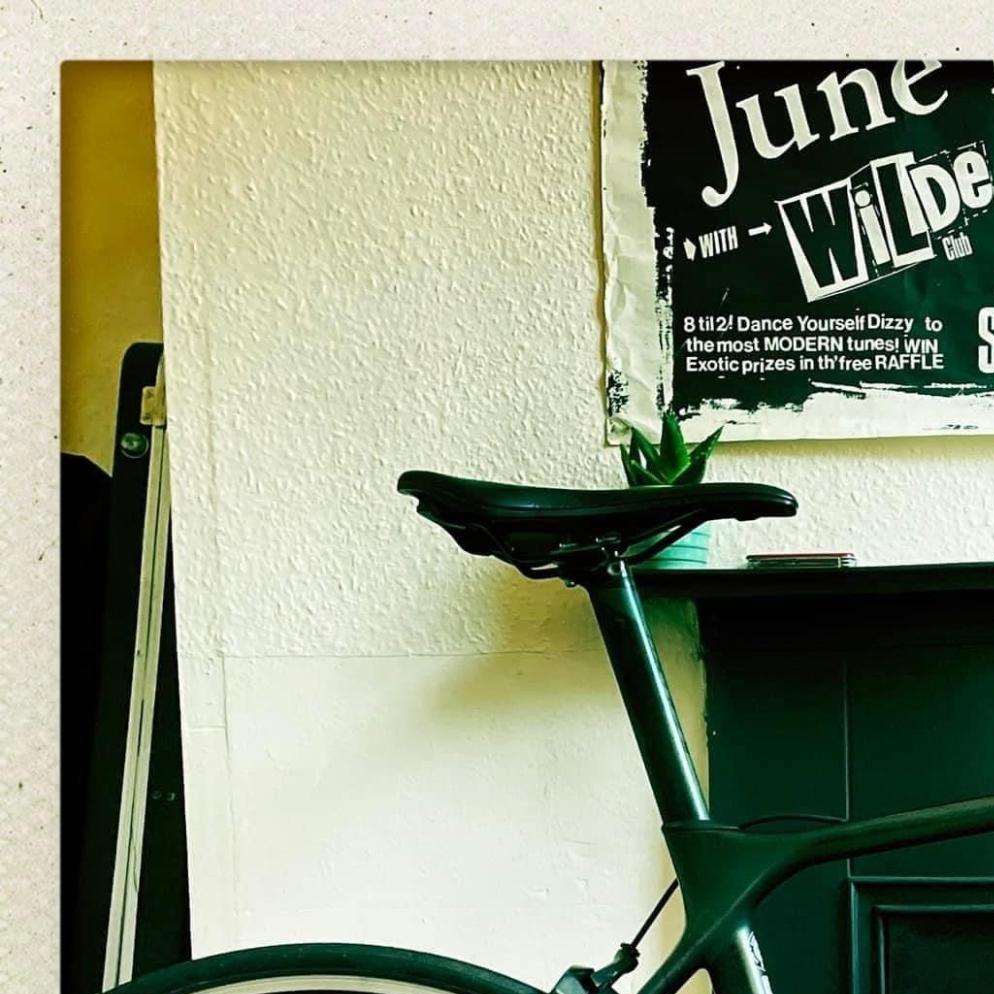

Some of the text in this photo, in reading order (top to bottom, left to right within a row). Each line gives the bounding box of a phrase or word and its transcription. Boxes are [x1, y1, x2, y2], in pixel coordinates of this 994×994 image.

[686, 60, 948, 207] June
[698, 226, 738, 259] WITH
[942, 231, 974, 261] Club
[737, 316, 794, 333] Dance
[797, 315, 865, 332] Yourself
[867, 313, 914, 333] Dizzy
[925, 316, 943, 333] to
[686, 336, 939, 354] the most MODERN tunes! WIN
[686, 357, 740, 373] Exotic
[741, 357, 796, 376] prizes
[799, 356, 815, 372] in
[875, 354, 944, 370] RAFFLE
